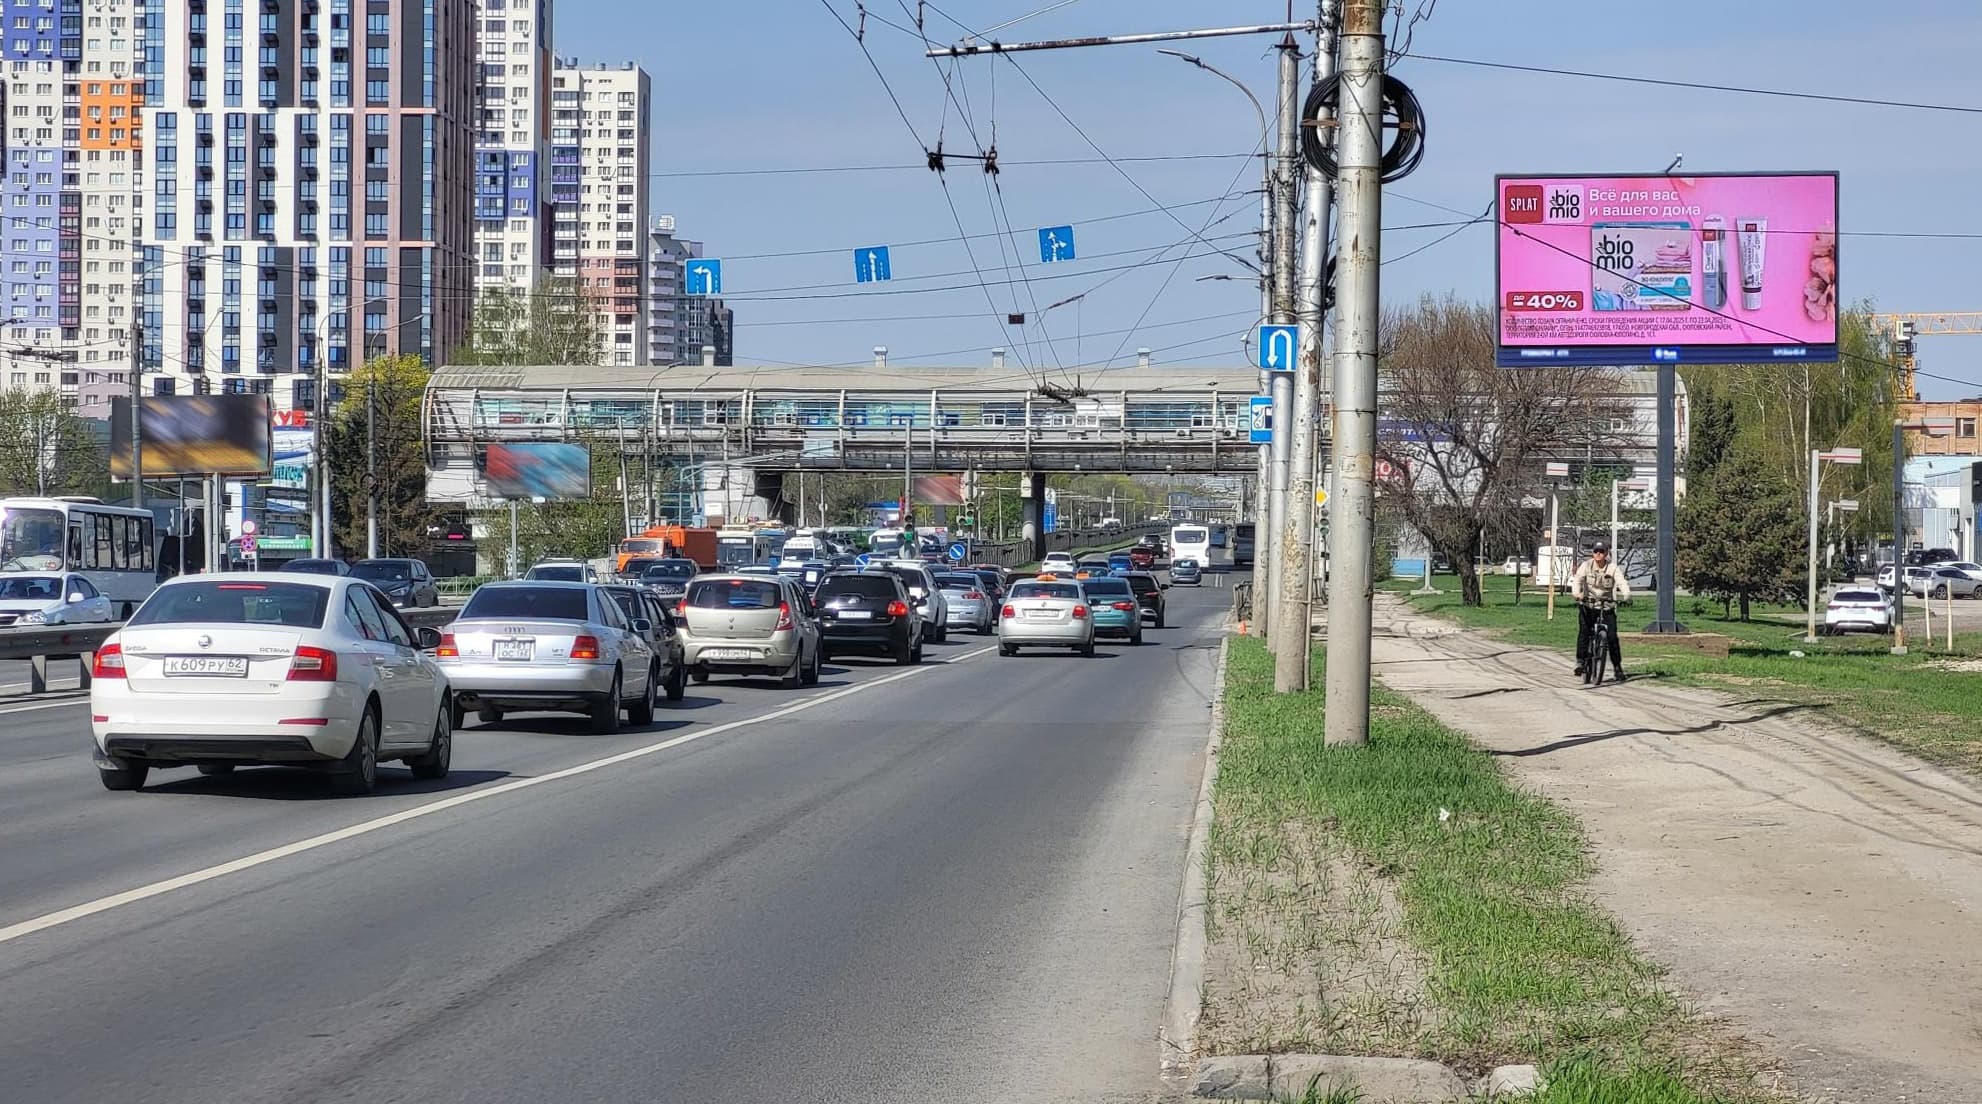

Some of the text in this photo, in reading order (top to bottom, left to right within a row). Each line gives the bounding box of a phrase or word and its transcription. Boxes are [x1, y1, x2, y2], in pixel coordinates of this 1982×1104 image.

[1553, 189, 1580, 207] bio
[1589, 188, 1679, 204] Всё для вас
[1510, 197, 1538, 211] SPLAT
[1589, 205, 1701, 217] и вашего дома
[1550, 206, 1580, 219] mio
[1601, 233, 1634, 255] bio
[1596, 255, 1634, 270] mio
